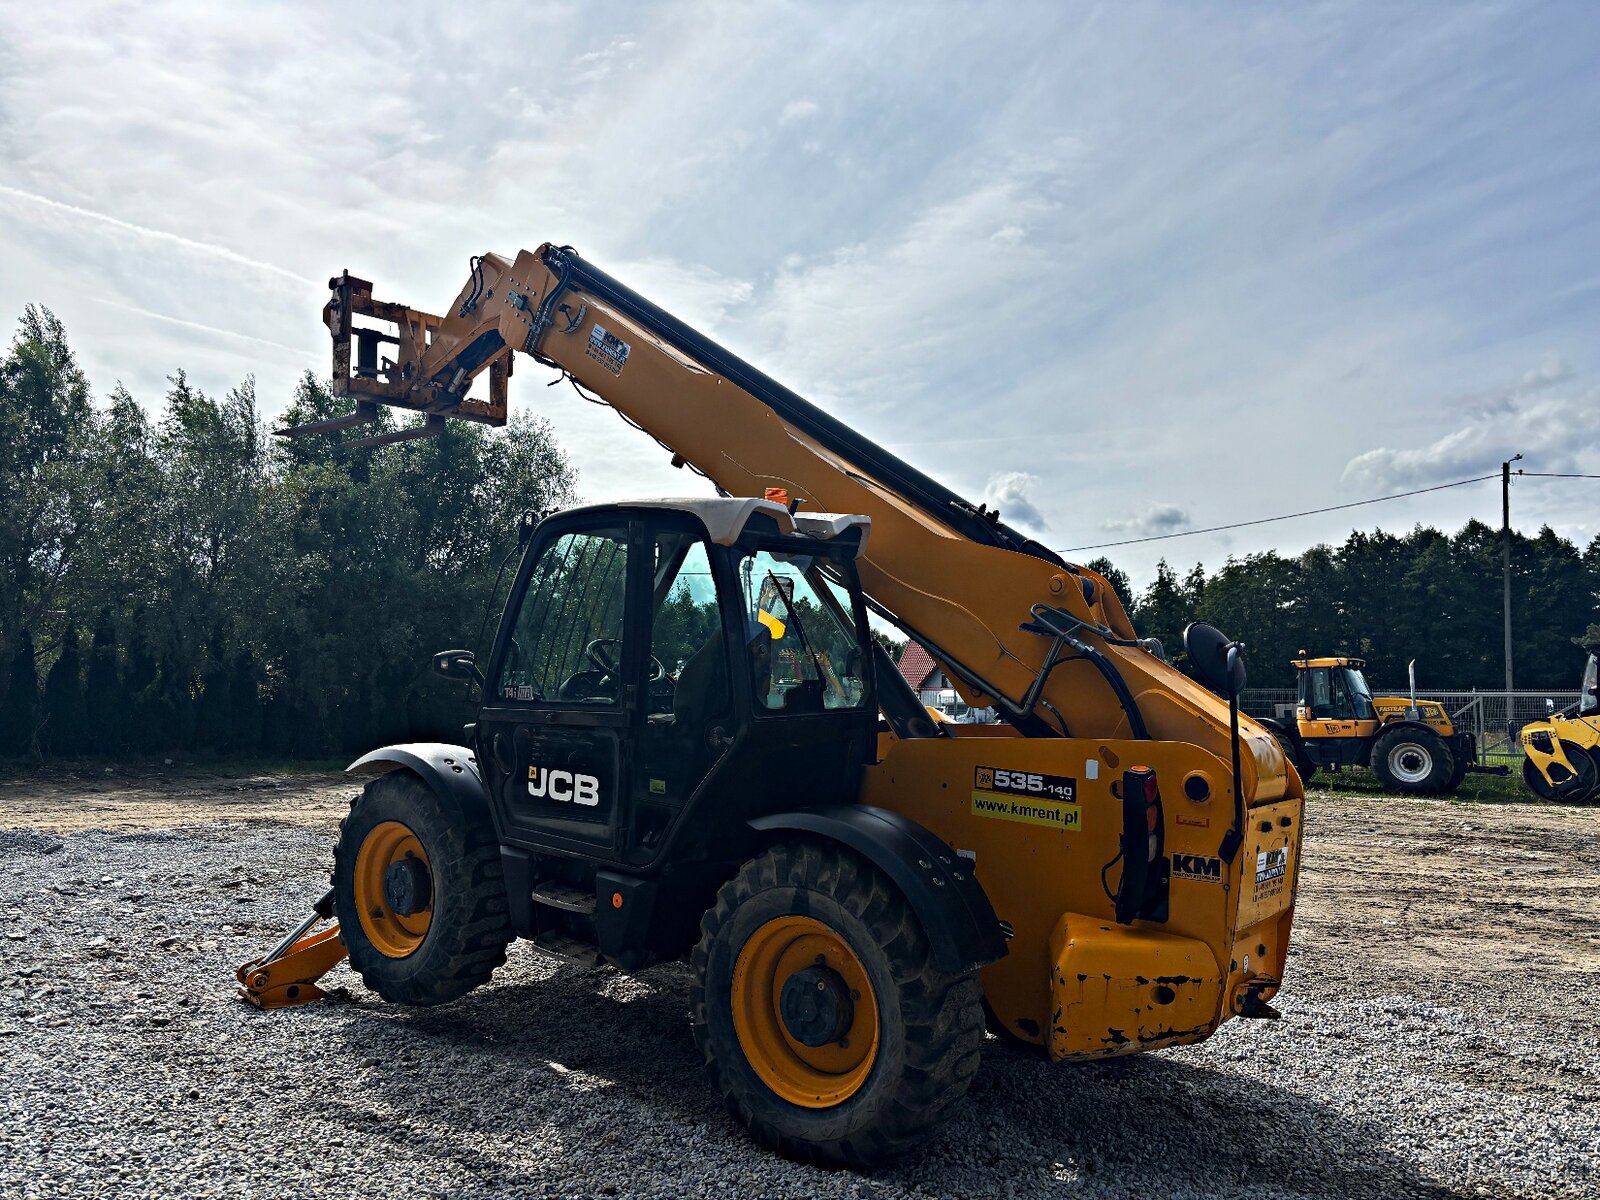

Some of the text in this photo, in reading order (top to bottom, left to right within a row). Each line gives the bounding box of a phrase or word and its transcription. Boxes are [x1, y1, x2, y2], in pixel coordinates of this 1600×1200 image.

[528, 768, 599, 806] JCB
[975, 799, 1078, 825] www.kmrent.pl
[1173, 854, 1221, 877] KM
